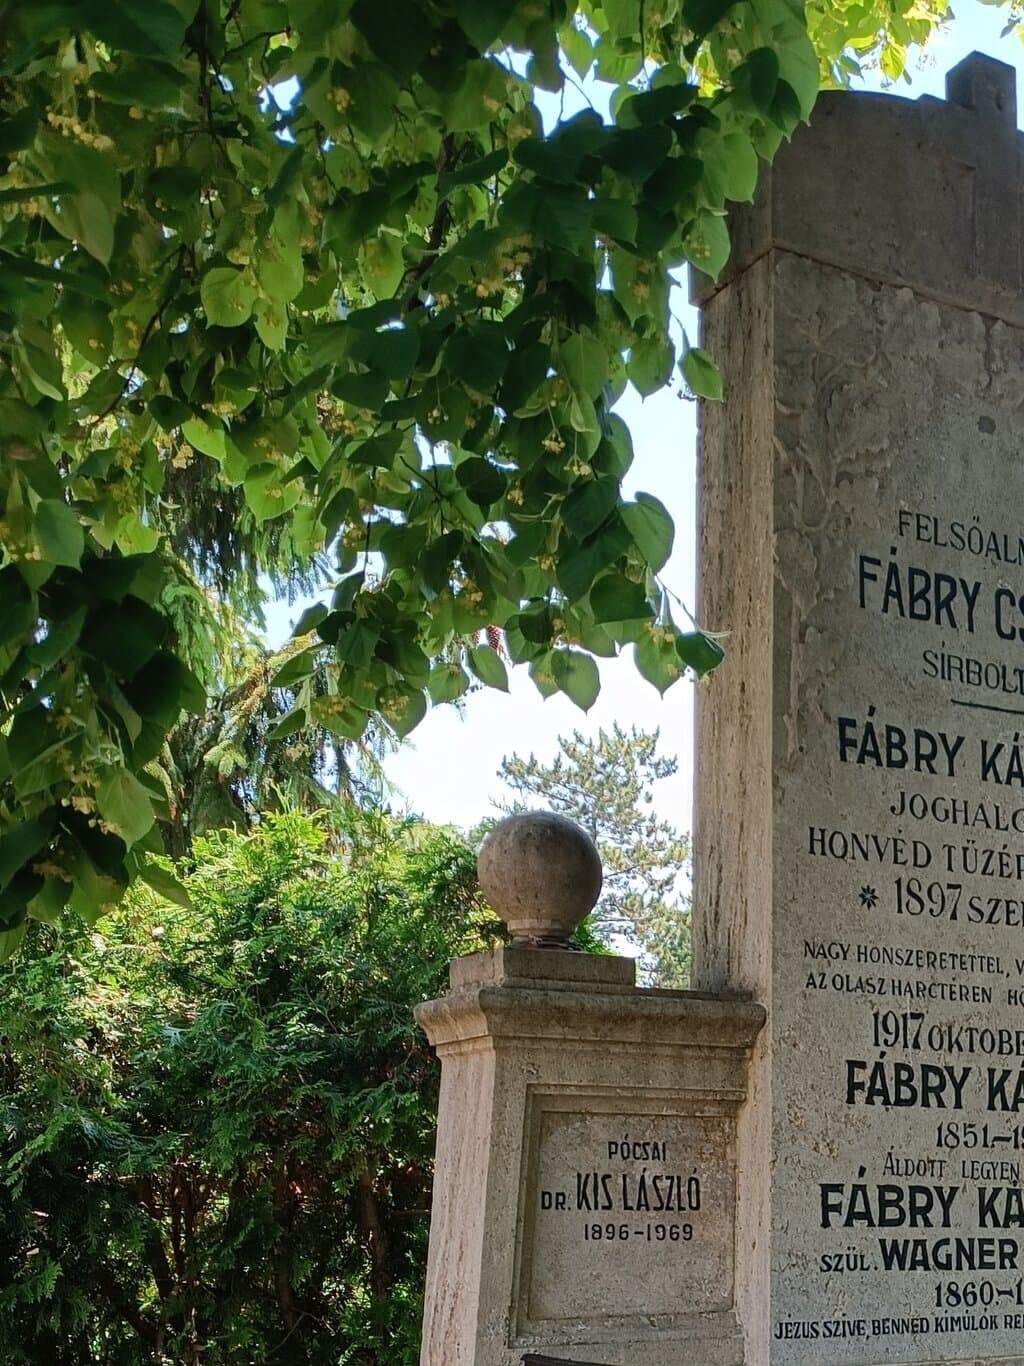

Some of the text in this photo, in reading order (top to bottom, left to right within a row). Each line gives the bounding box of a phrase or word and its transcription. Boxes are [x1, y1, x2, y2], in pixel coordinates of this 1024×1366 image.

[858, 546, 981, 634] FÁBRY
[837, 705, 966, 778] FÁBRY
[808, 826, 932, 869] HONVÉD
[894, 877, 963, 921] 1897
[803, 939, 850, 961] NAGY
[857, 945, 1010, 978] HONSZERETETTEL,
[805, 972, 828, 990] AZ
[831, 973, 887, 995] OLASZ
[891, 977, 992, 1003] HARCTÉREN
[872, 1010, 925, 1050] 1917
[845, 1051, 972, 1110] FÁBRY
[607, 1133, 667, 1162] PÓCSAI
[882, 1146, 946, 1178] ÁLDOTT
[962, 1160, 1020, 1180] LEGYEN
[540, 1168, 701, 1212] DR. KIS LÁSZLÓ
[819, 1165, 960, 1229] FÁBRY
[584, 1223, 693, 1242] 1896-1969
[819, 1246, 878, 1274] SZÜL.
[878, 1238, 1019, 1271] WAGNER
[774, 1312, 820, 1340] JÉZUS
[872, 1317, 930, 1336] BENNED
